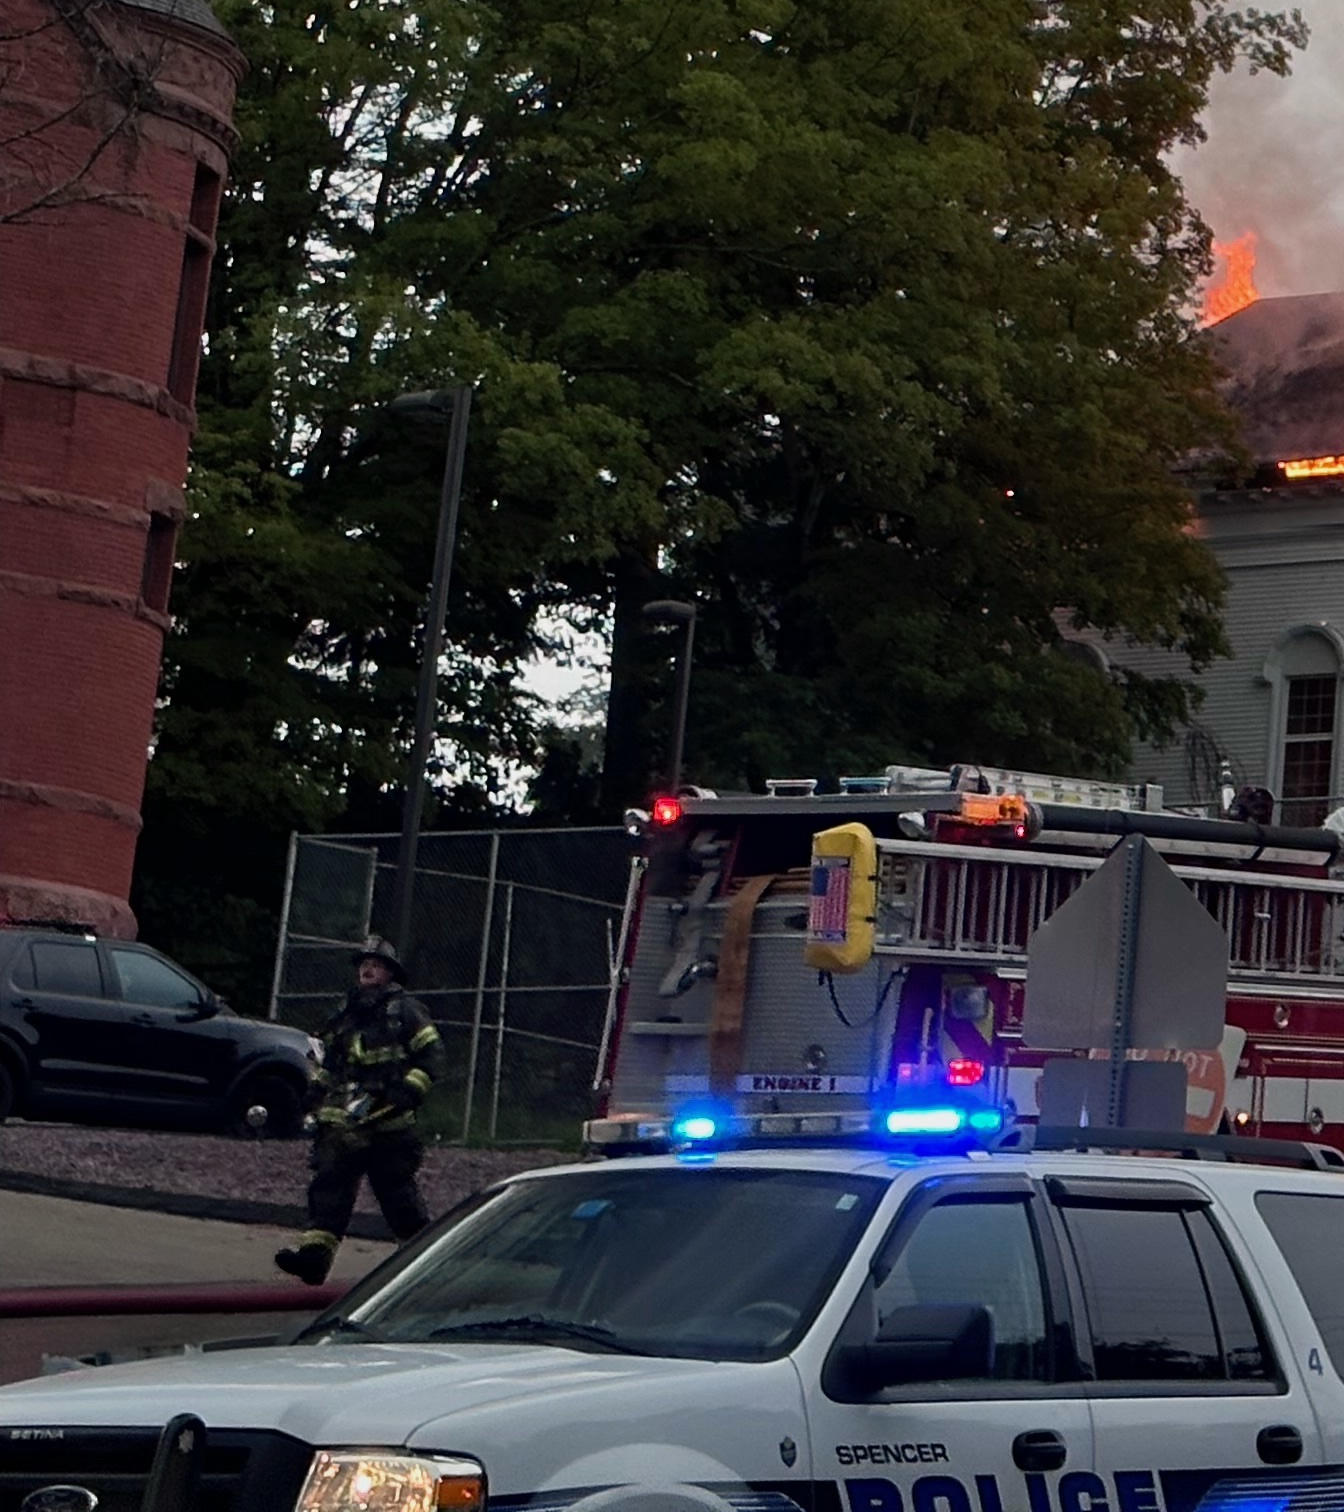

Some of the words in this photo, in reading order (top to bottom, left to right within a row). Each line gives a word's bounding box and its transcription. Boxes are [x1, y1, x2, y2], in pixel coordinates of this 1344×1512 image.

[752, 1076, 822, 1091] ENGINE
[1308, 1347, 1323, 1376] 4
[10, 1429, 65, 1440] SETINA
[835, 1442, 949, 1465] SPENCER
[844, 1470, 1158, 1512] POLICE
